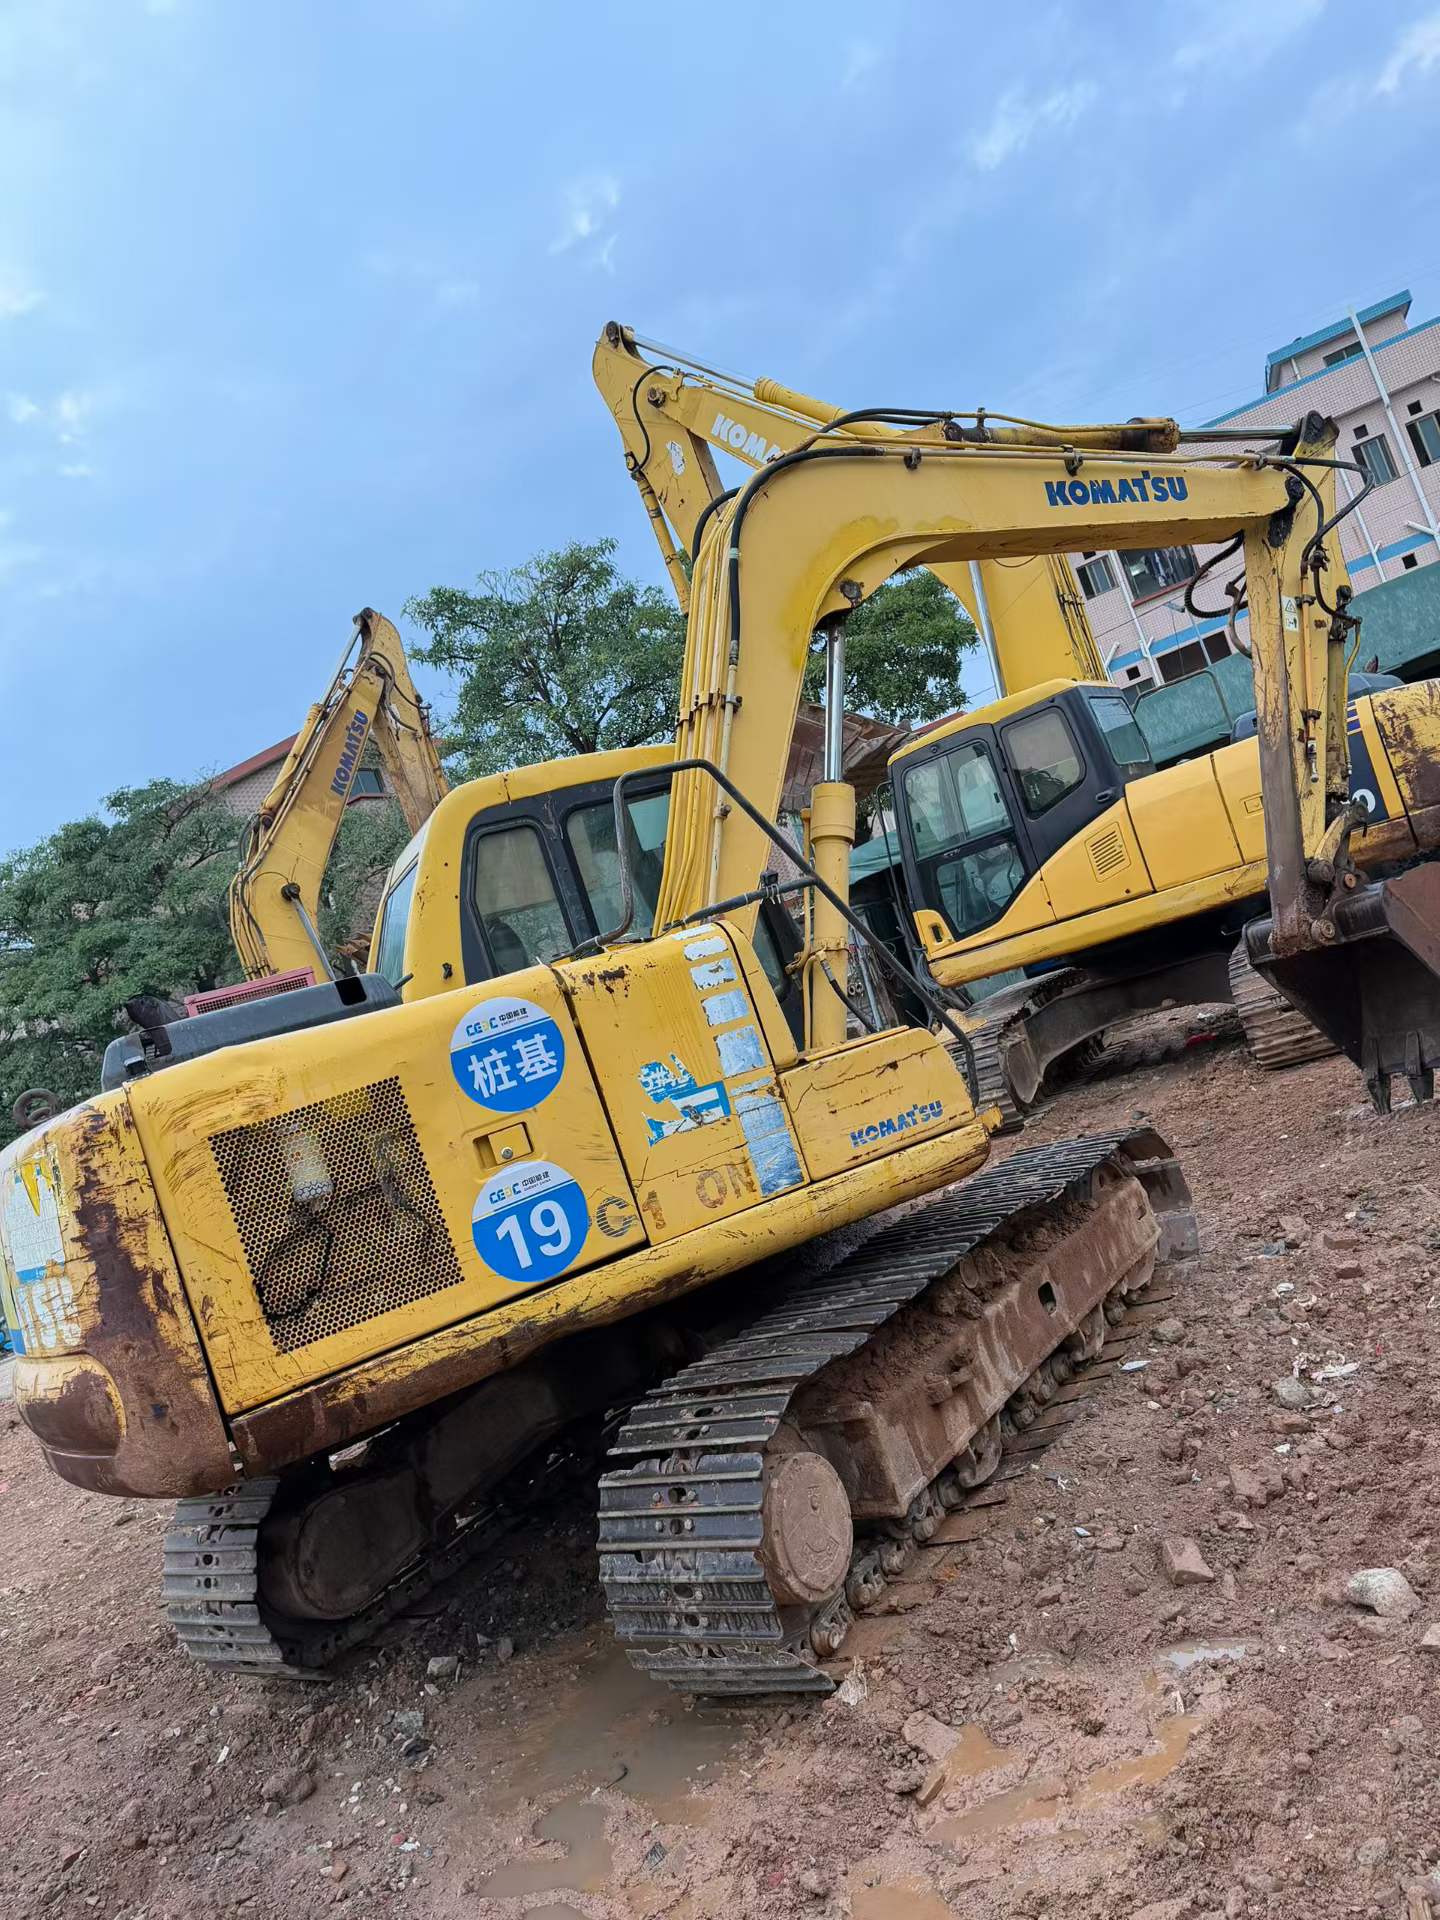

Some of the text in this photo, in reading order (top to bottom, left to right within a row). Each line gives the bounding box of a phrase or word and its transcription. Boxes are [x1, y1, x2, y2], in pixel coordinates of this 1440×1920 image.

[1044, 470, 1188, 507] KOMATSU
[330, 709, 368, 796] KOMATSU
[498, 1007, 528, 1021] 中国能建
[467, 1033, 558, 1099] 桩基
[850, 1100, 944, 1147] KOMATSU
[521, 1171, 551, 1187] 中国能建
[496, 1200, 572, 1269] 19
